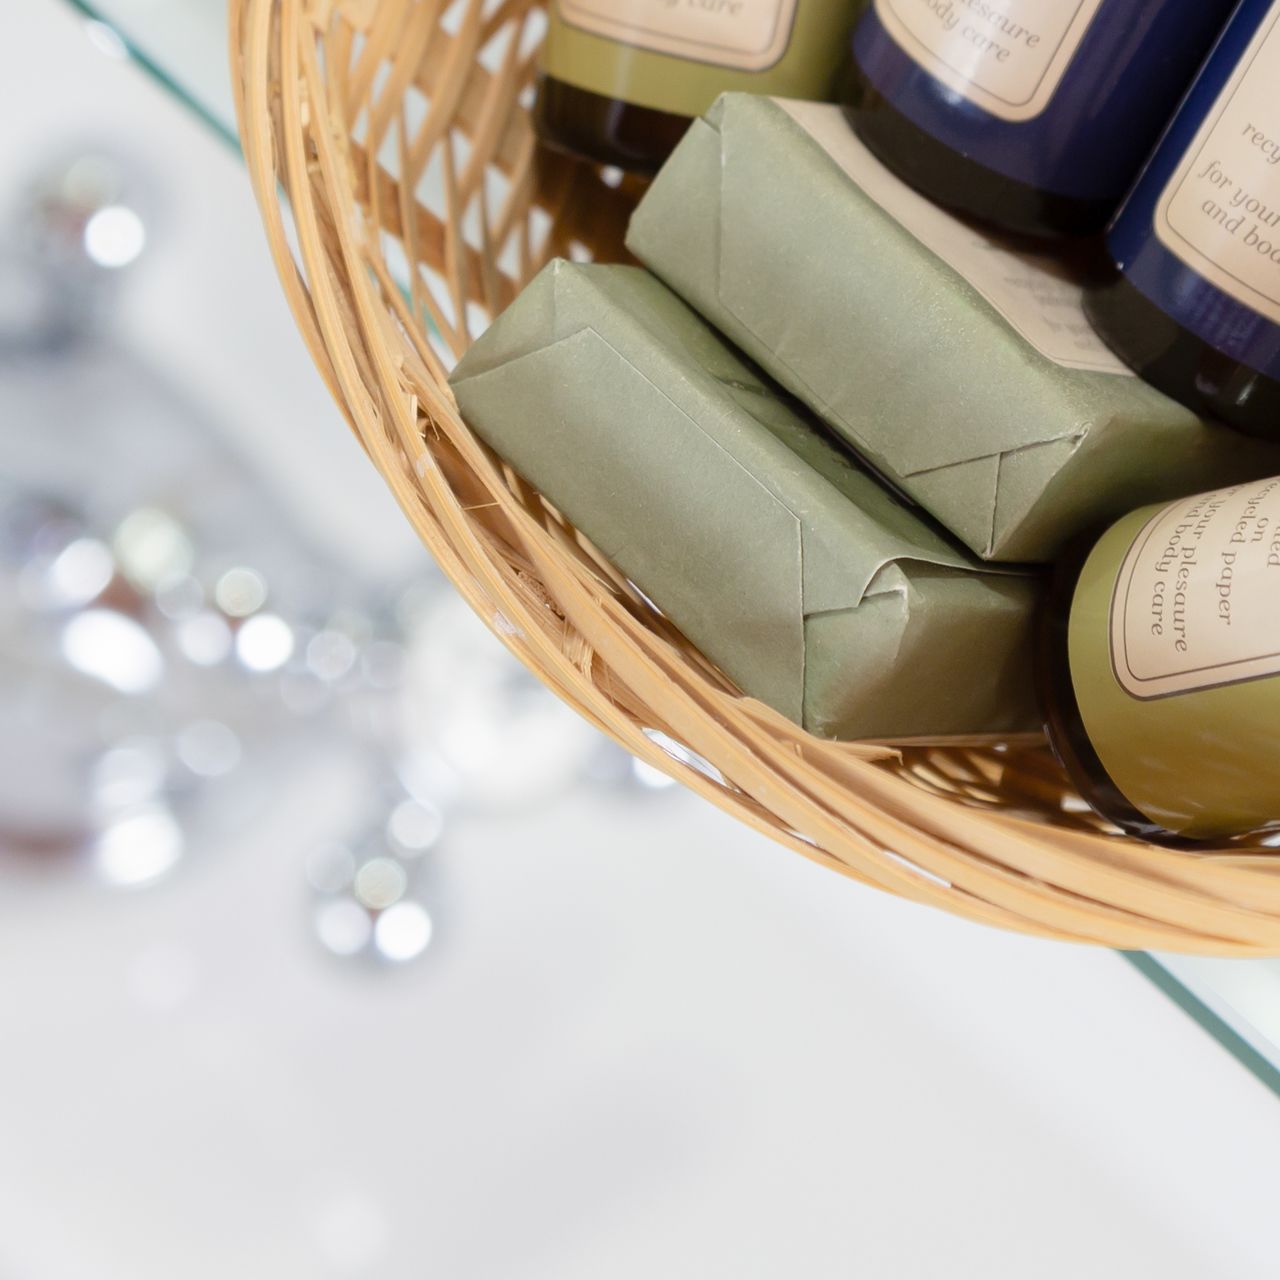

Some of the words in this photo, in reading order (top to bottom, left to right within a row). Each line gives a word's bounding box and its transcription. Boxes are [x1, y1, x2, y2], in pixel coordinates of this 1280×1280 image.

[961, 24, 1010, 63] care
[1198, 160, 1233, 189] for
[1201, 199, 1246, 235] and
[1193, 499, 1225, 540] your
[1250, 516, 1270, 544] on
[1154, 522, 1192, 573] body
[1151, 580, 1166, 637] care
[1173, 546, 1198, 653] plesaure
[1215, 551, 1237, 626] paper
